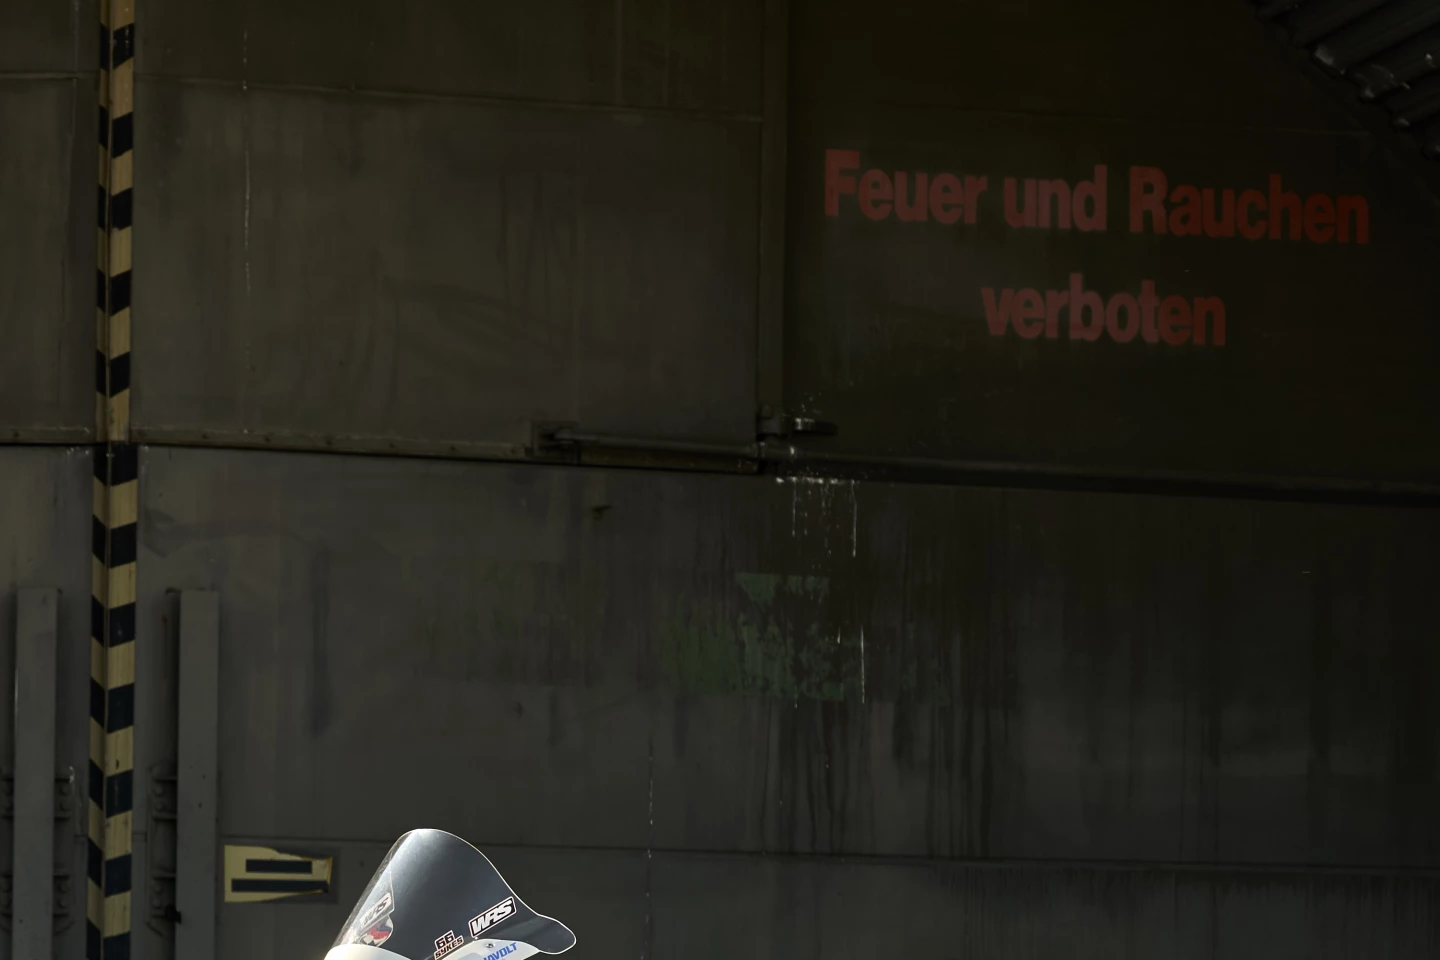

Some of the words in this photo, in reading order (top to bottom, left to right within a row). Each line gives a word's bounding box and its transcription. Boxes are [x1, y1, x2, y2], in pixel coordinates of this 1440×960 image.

[824, 148, 988, 225] Feuer
[1003, 165, 1107, 232] und
[1129, 165, 1370, 244] Rauchen
[980, 272, 1226, 346] verboten
[471, 899, 513, 935] WRS
[435, 931, 454, 950] 66
[435, 937, 463, 959] SYKES
